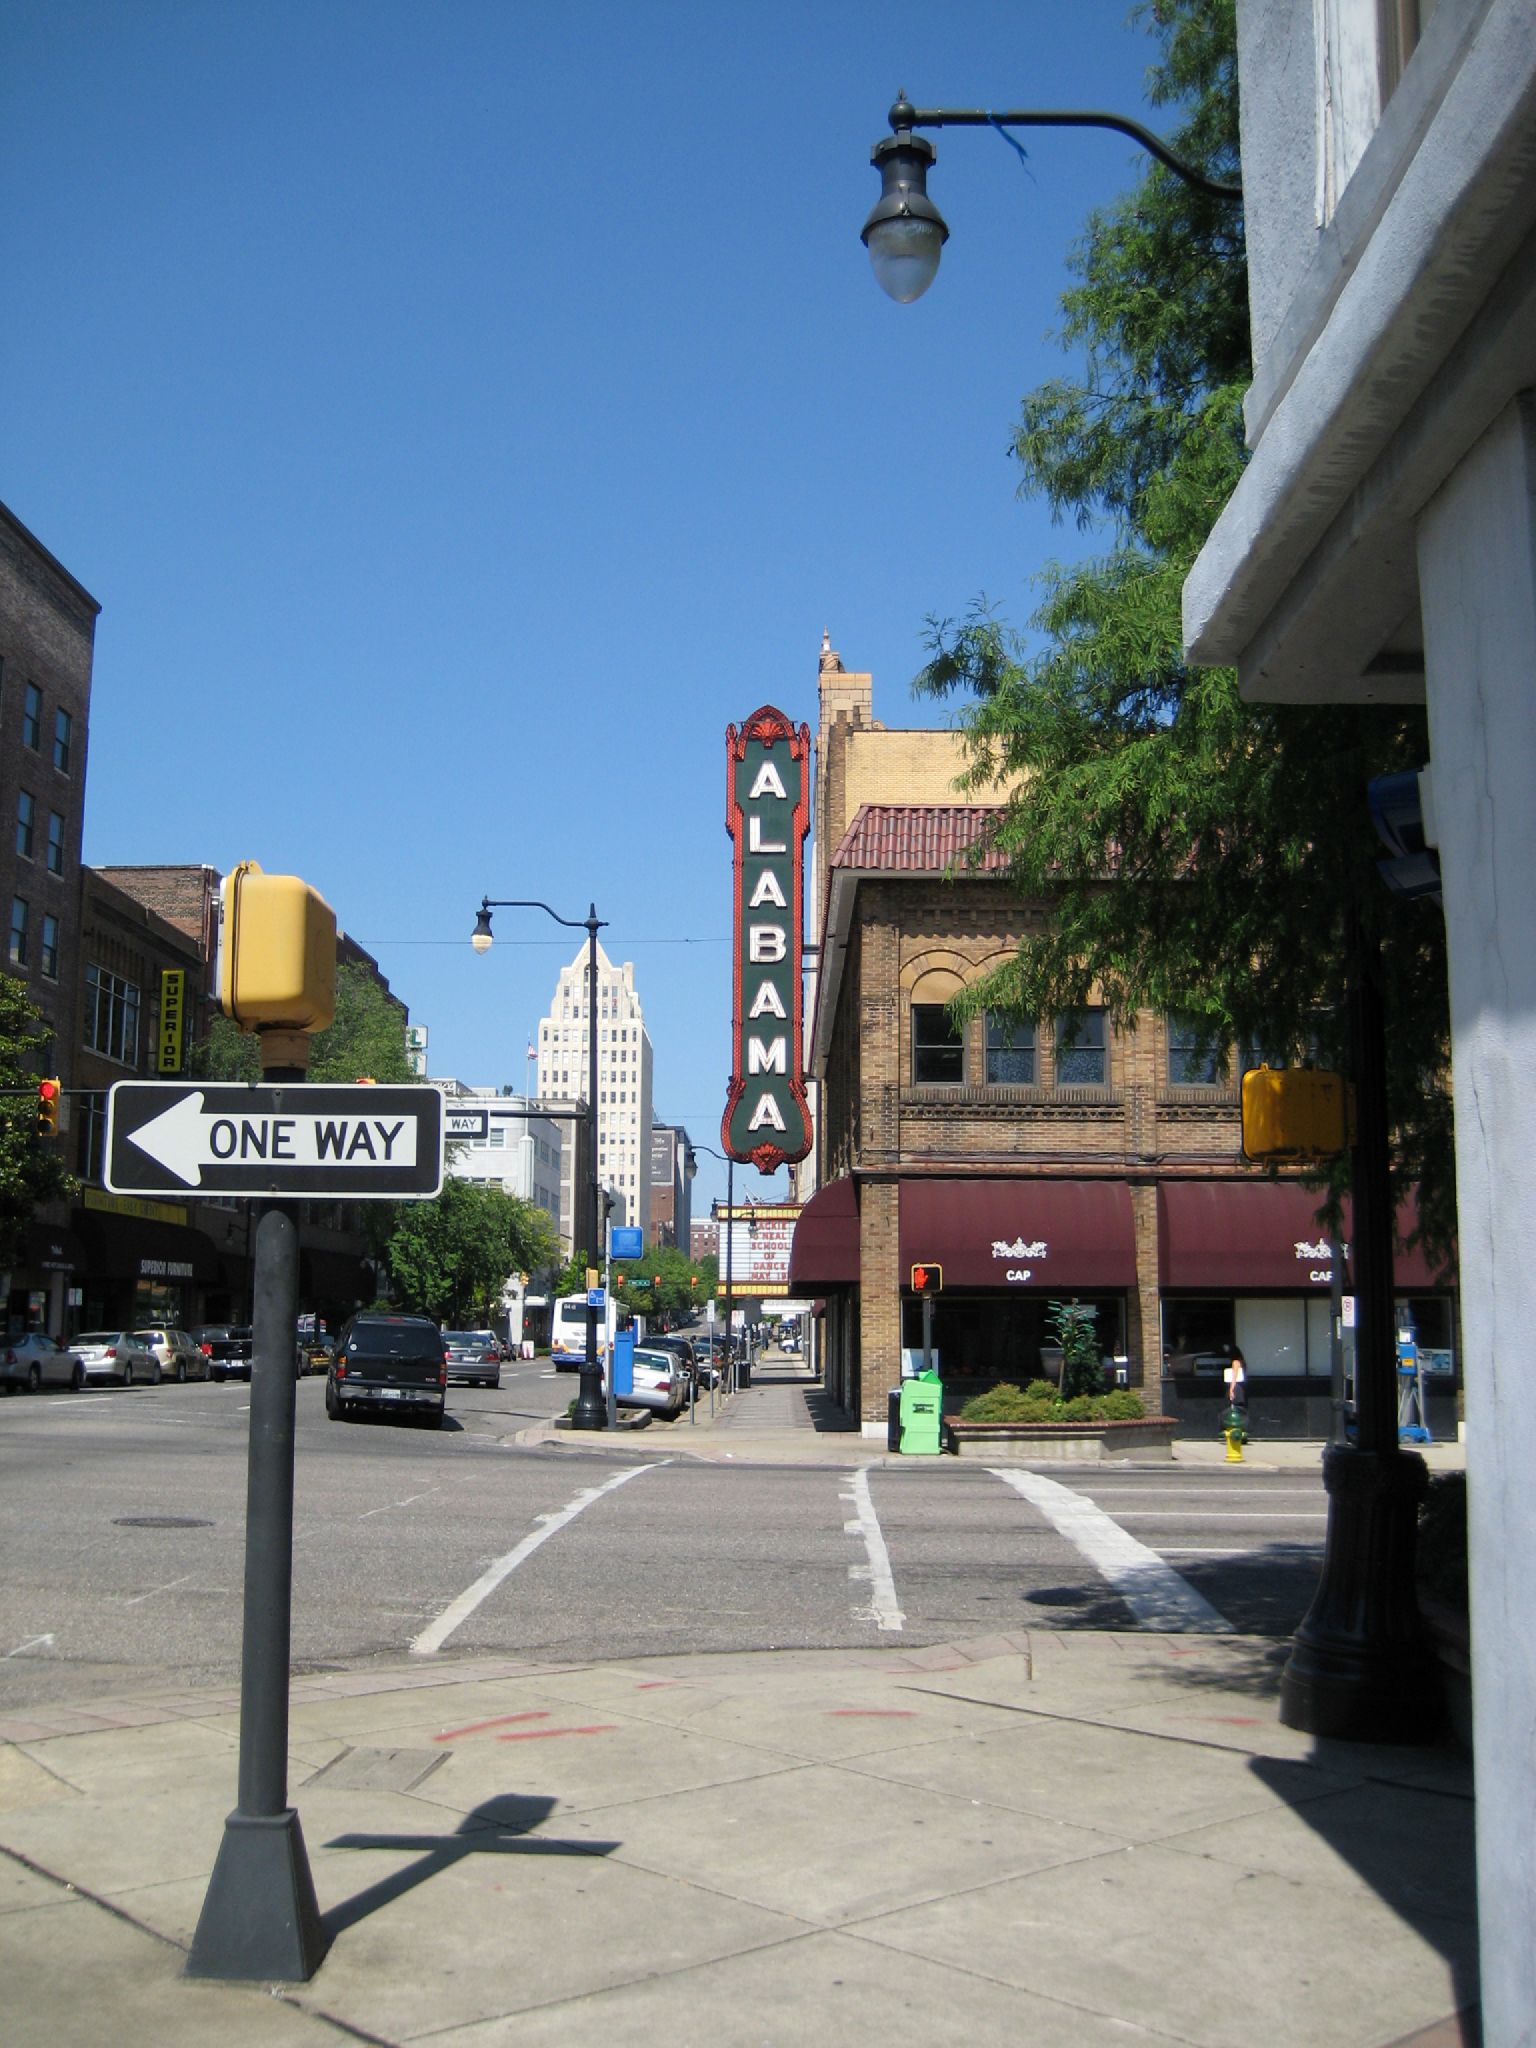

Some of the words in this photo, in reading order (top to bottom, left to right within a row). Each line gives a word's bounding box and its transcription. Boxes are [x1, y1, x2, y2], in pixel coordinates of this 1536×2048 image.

[748, 760, 788, 1133] ALABAMA
[163, 974, 179, 1067] SUPERIOR
[451, 1119, 477, 1130] WAY
[210, 1119, 296, 1159] ONE
[315, 1121, 405, 1160] WAY
[757, 1220, 787, 1230] ACKIE
[751, 1242, 790, 1250] SCHOOL
[764, 1252, 776, 1260] OF
[140, 1259, 166, 1275] SUPERIOR
[167, 1262, 193, 1277] FURNITURE
[753, 1262, 786, 1270] DANCE
[751, 1272, 770, 1280] MAY
[1006, 1270, 1031, 1281] CAP
